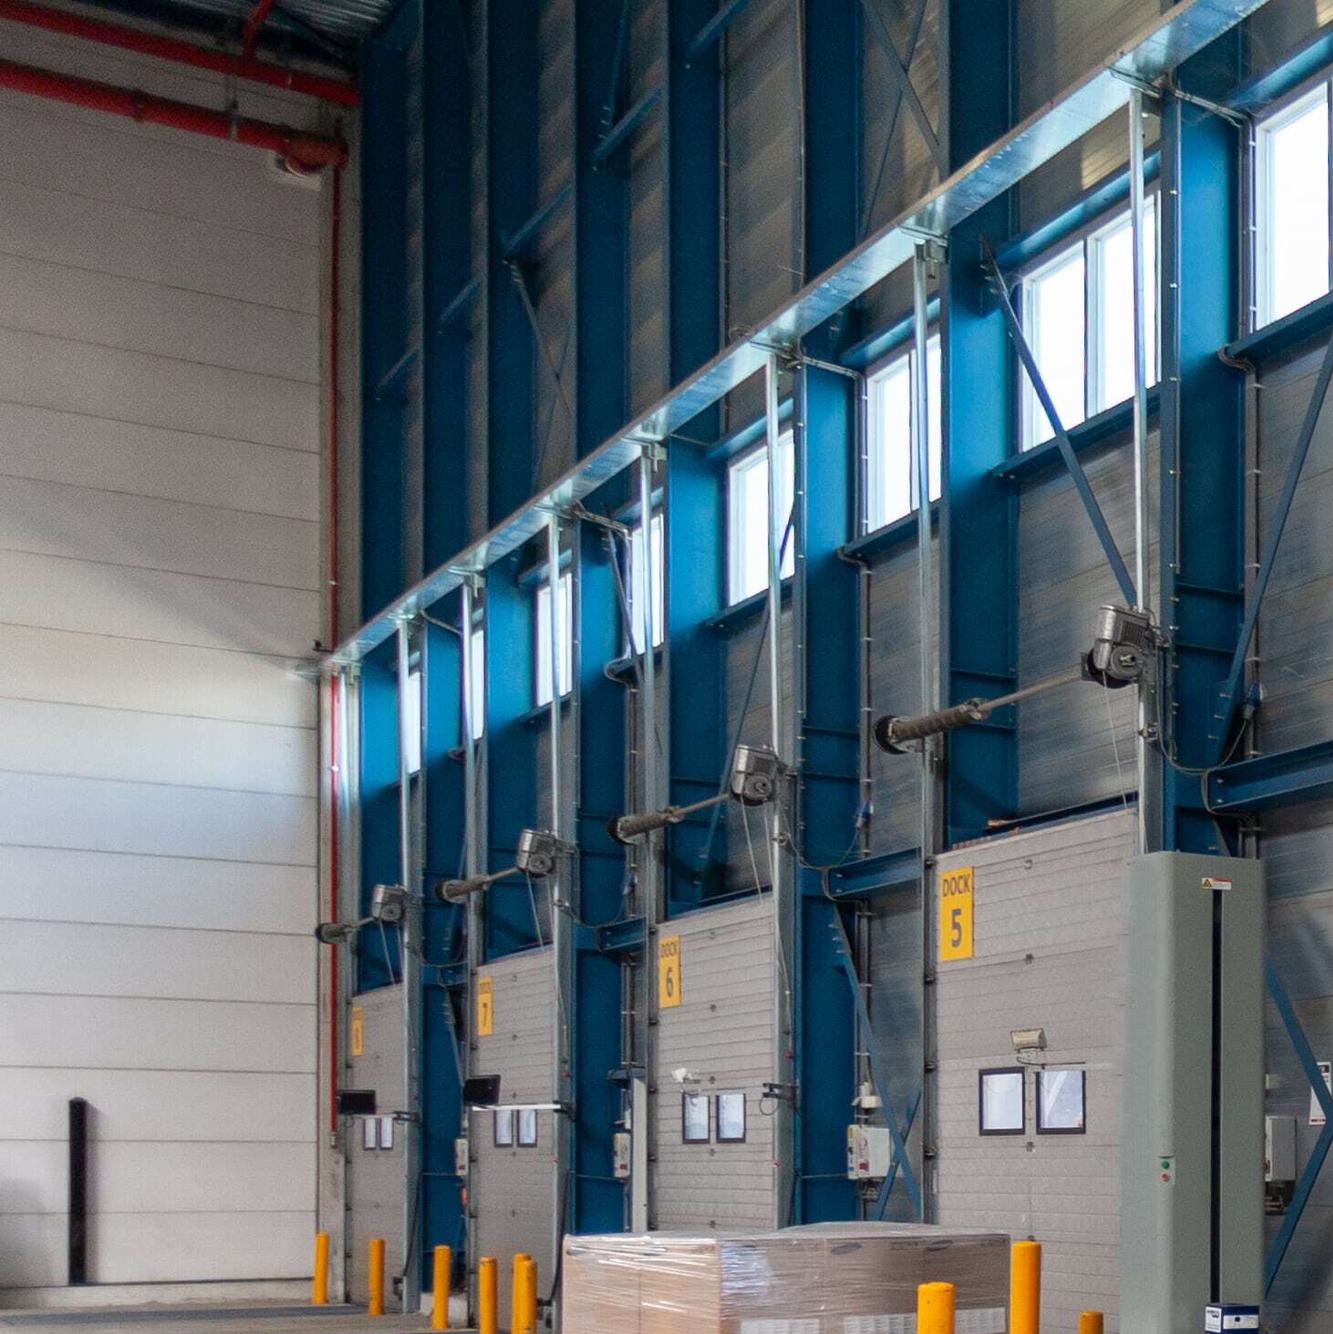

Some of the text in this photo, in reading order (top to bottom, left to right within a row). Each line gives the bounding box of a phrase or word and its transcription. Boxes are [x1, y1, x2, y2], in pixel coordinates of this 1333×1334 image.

[943, 872, 971, 897] DOCK
[951, 908, 962, 948] 5
[666, 965, 674, 998] 6
